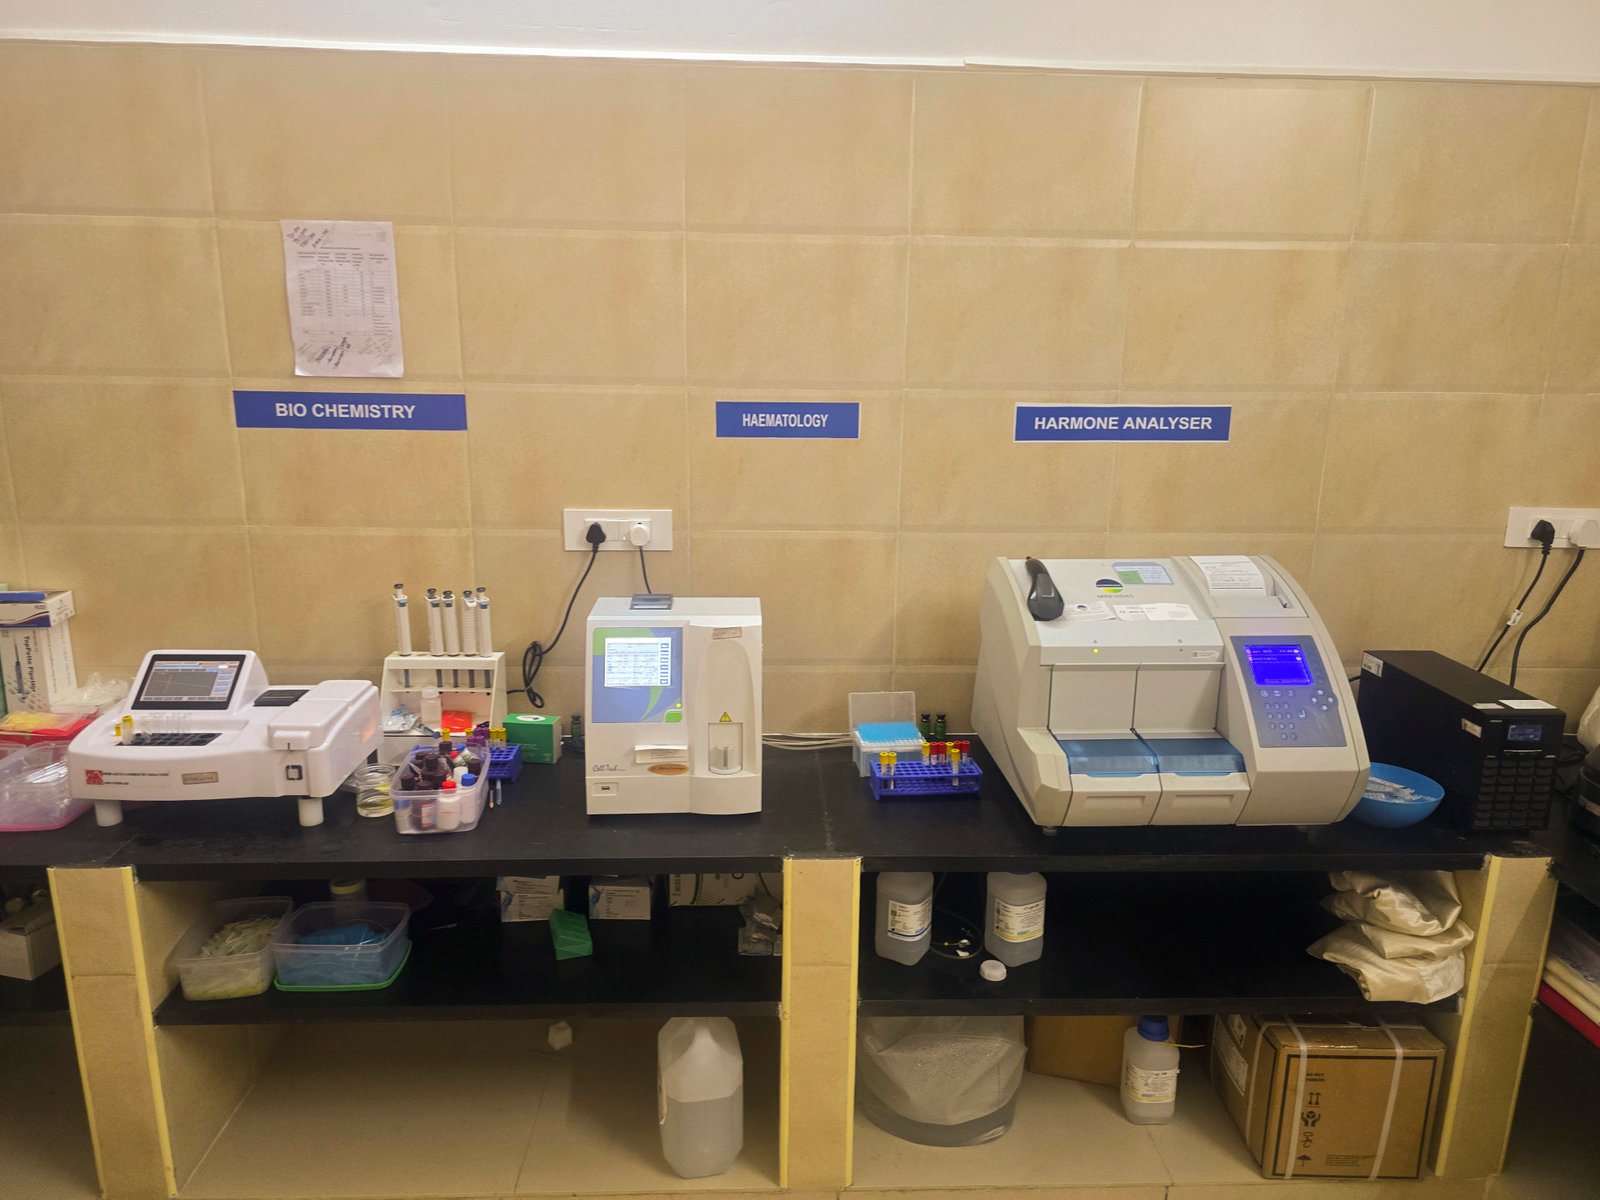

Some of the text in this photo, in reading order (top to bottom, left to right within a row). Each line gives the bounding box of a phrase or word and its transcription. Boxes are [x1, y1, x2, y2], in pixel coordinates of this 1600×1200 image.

[275, 402, 415, 419] BIO CHEMISTRY
[742, 413, 828, 427] HAEMATOLOGY
[1034, 416, 1212, 430] HARMONE ANALYSER
